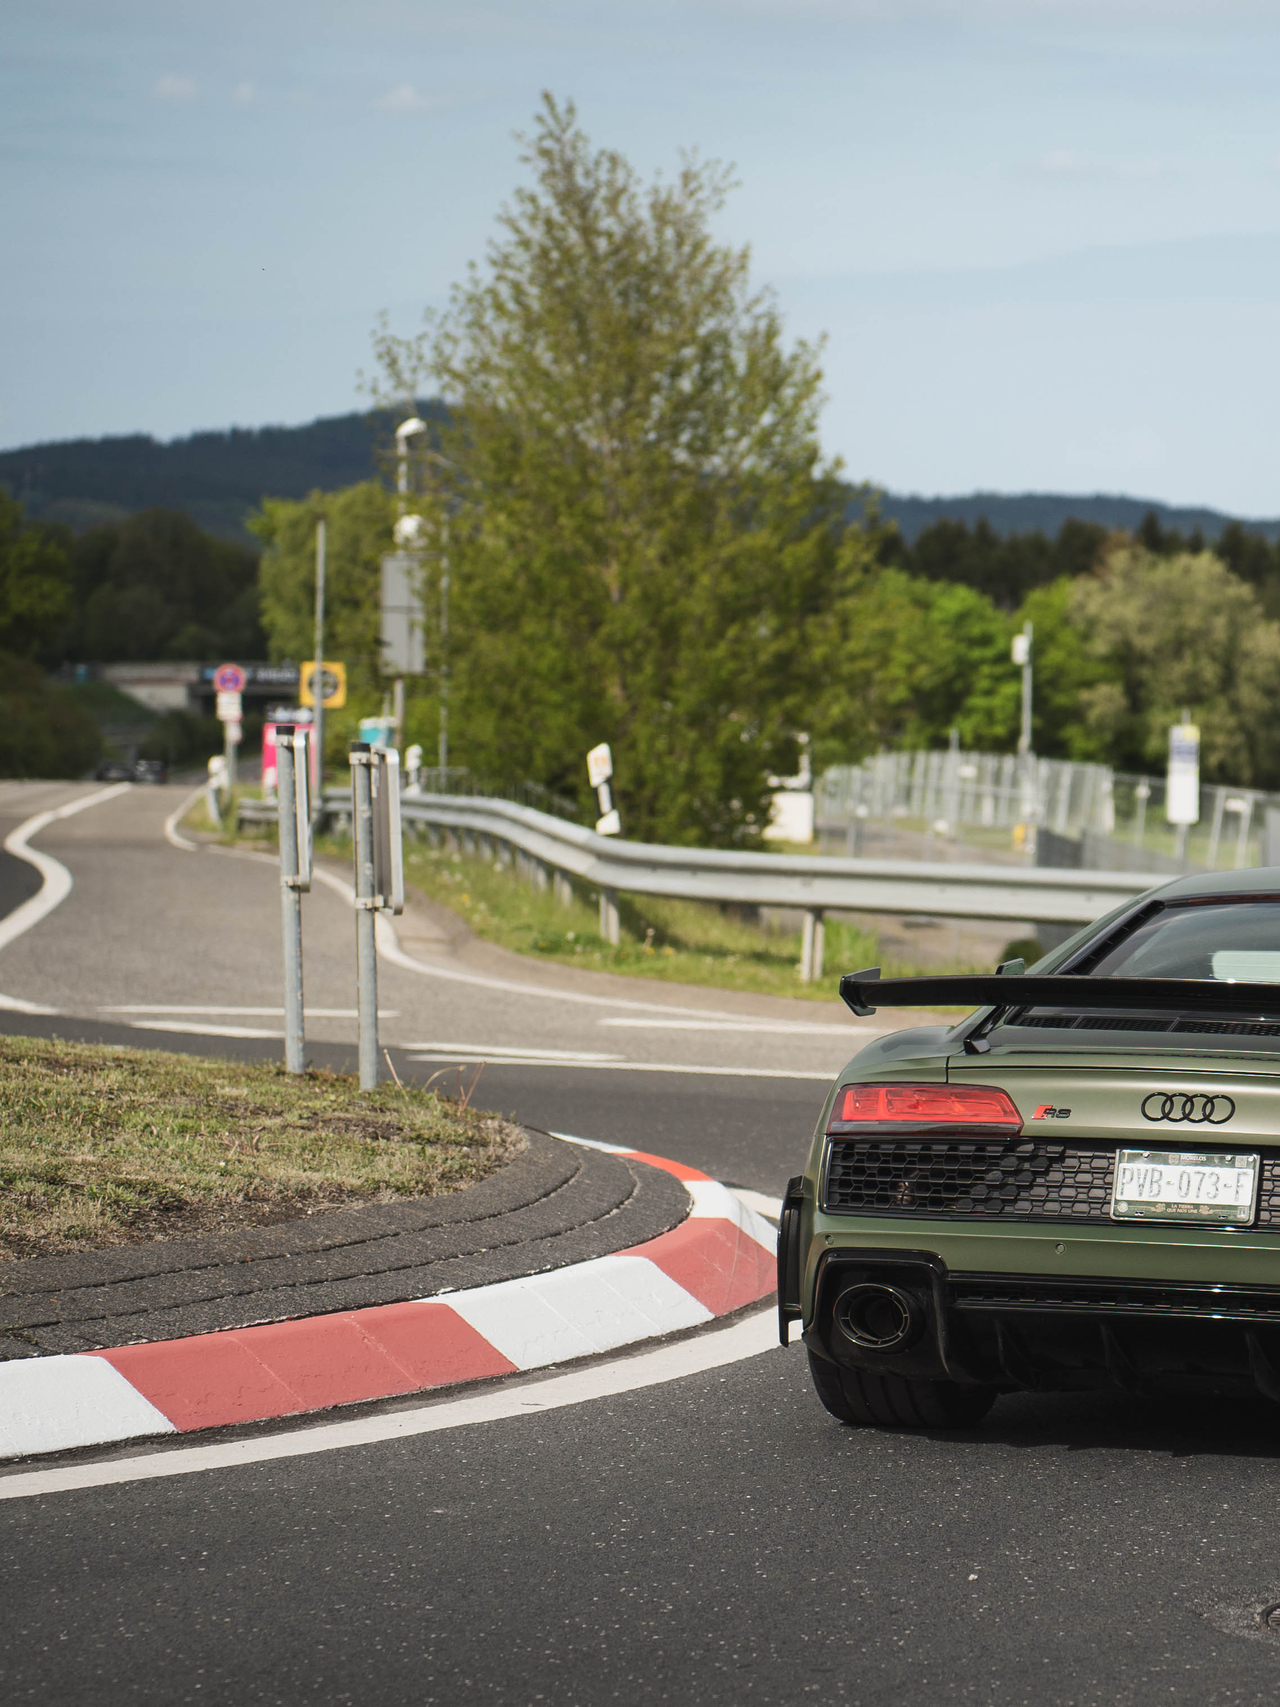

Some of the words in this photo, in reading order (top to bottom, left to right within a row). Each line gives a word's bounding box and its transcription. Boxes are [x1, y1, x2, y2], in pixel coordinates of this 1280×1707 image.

[1036, 1106, 1072, 1119] R8
[1180, 1154, 1207, 1162] MORELOS
[1119, 1166, 1251, 1202] PVB-073-F
